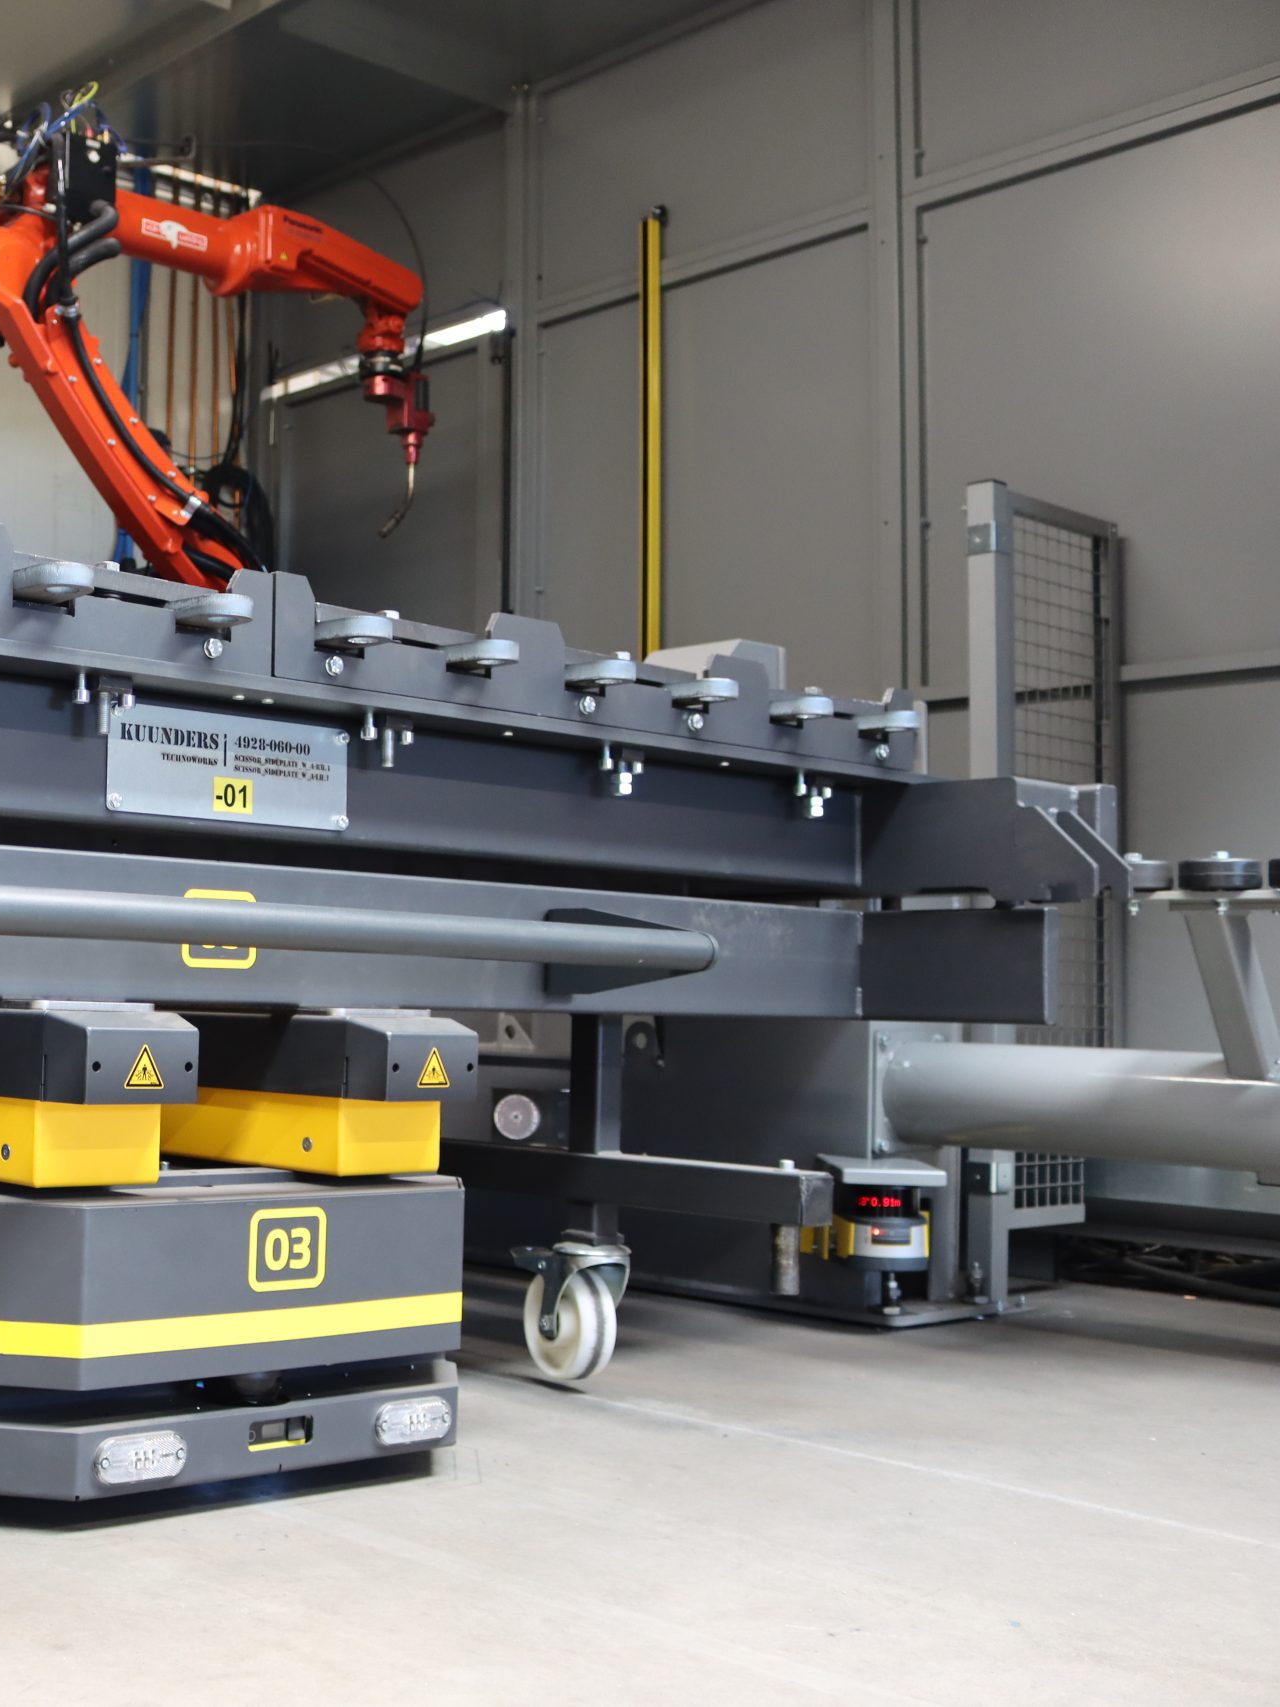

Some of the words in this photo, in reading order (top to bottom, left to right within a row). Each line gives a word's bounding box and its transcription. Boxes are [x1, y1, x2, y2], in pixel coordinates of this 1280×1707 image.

[120, 722, 220, 751] KUUNDERS
[234, 735, 311, 756] 4928-060-00
[161, 752, 219, 767] TECHNOWORKS
[215, 783, 247, 808] -01
[264, 1227, 311, 1271] 03
